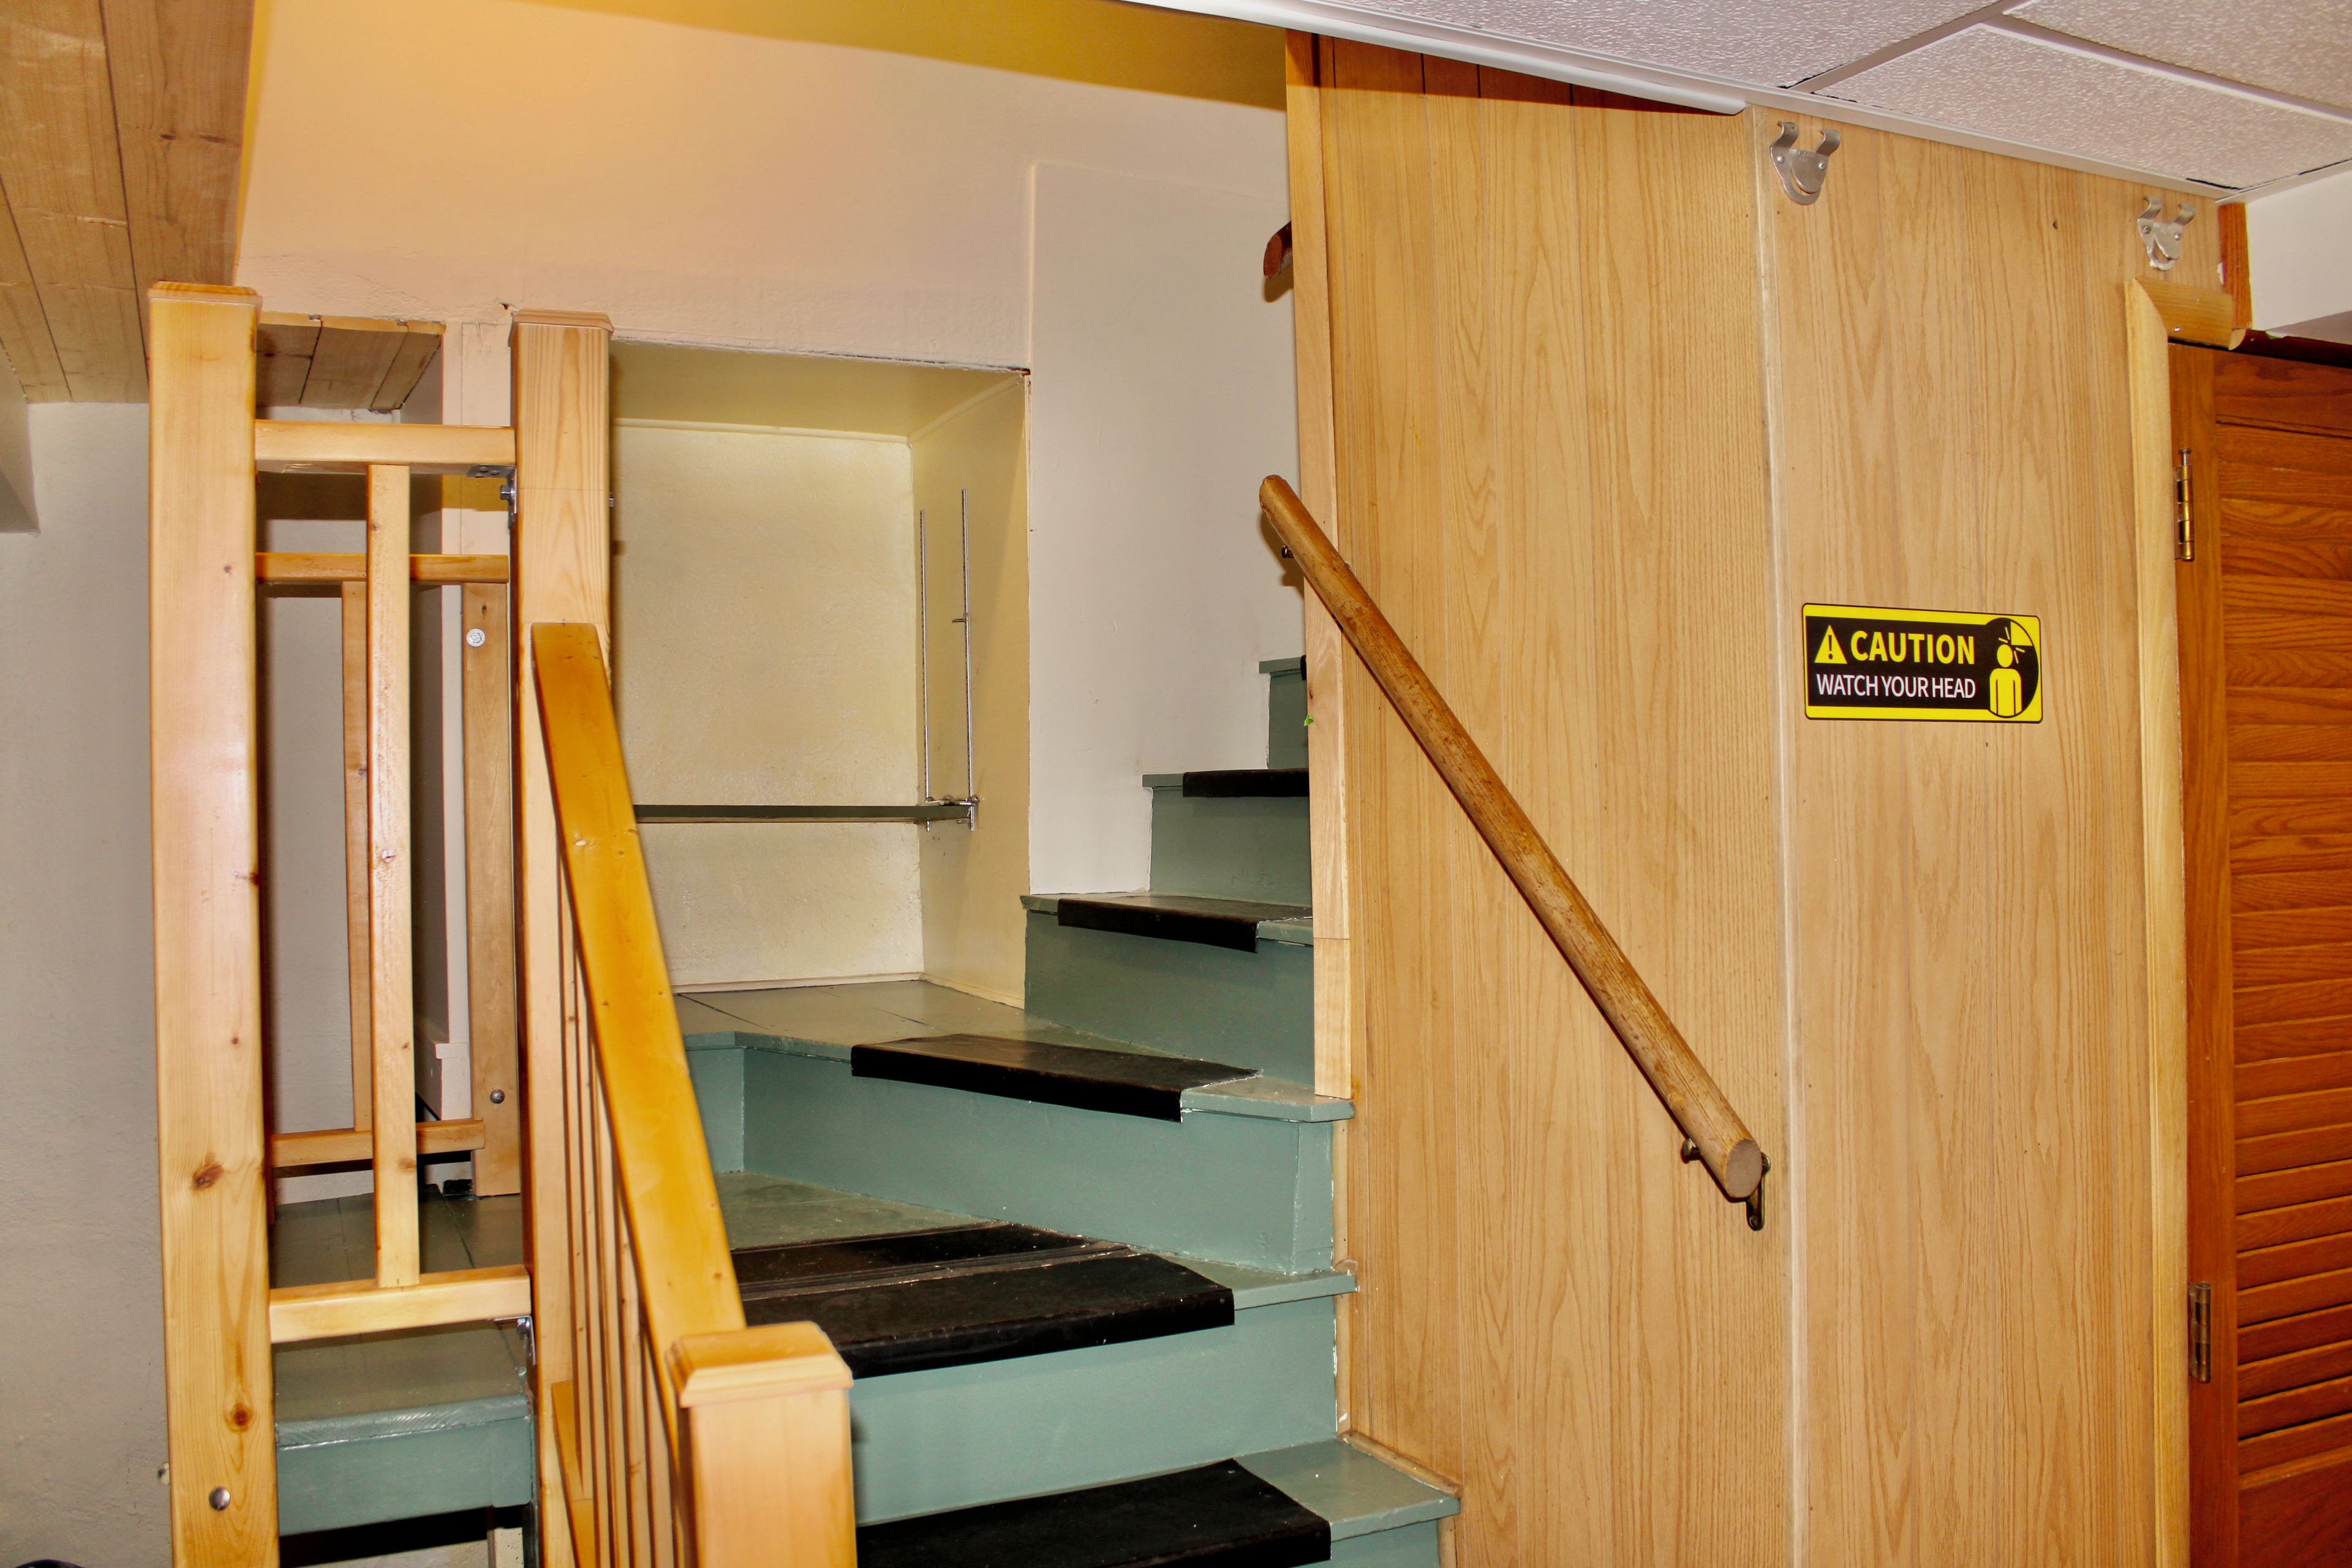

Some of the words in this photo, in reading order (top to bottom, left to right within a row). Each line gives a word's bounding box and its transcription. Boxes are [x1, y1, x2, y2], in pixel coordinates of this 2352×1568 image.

[1850, 630, 1975, 664] CAUTION
[1817, 674, 1879, 696] WATCH
[1882, 676, 1929, 698] YOUR
[1932, 677, 1976, 698] HEAD
